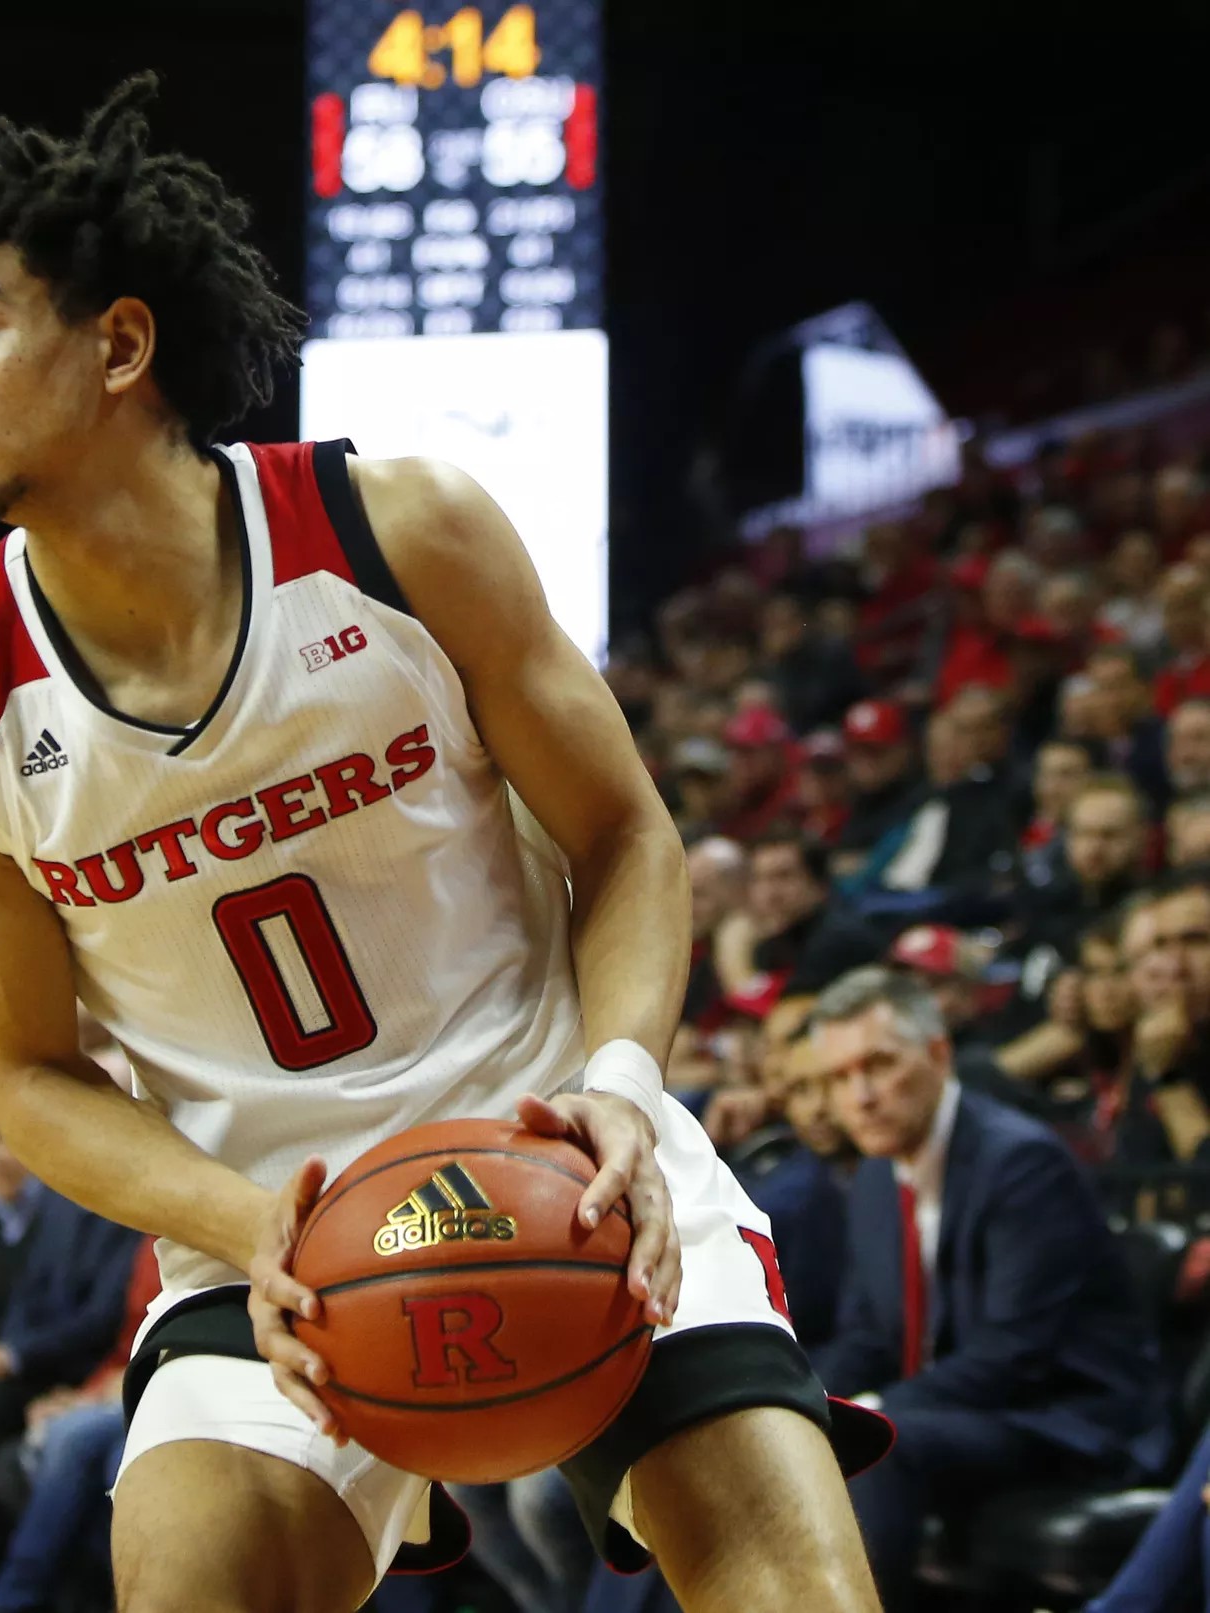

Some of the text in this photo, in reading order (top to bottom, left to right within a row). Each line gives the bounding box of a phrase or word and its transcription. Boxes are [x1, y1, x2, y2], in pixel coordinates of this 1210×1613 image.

[367, 4, 541, 89] 4:14
[31, 724, 436, 907] RUTGERS
[212, 873, 378, 1072] 0
[373, 1208, 517, 1256] adidas
[402, 1289, 517, 1388] R
